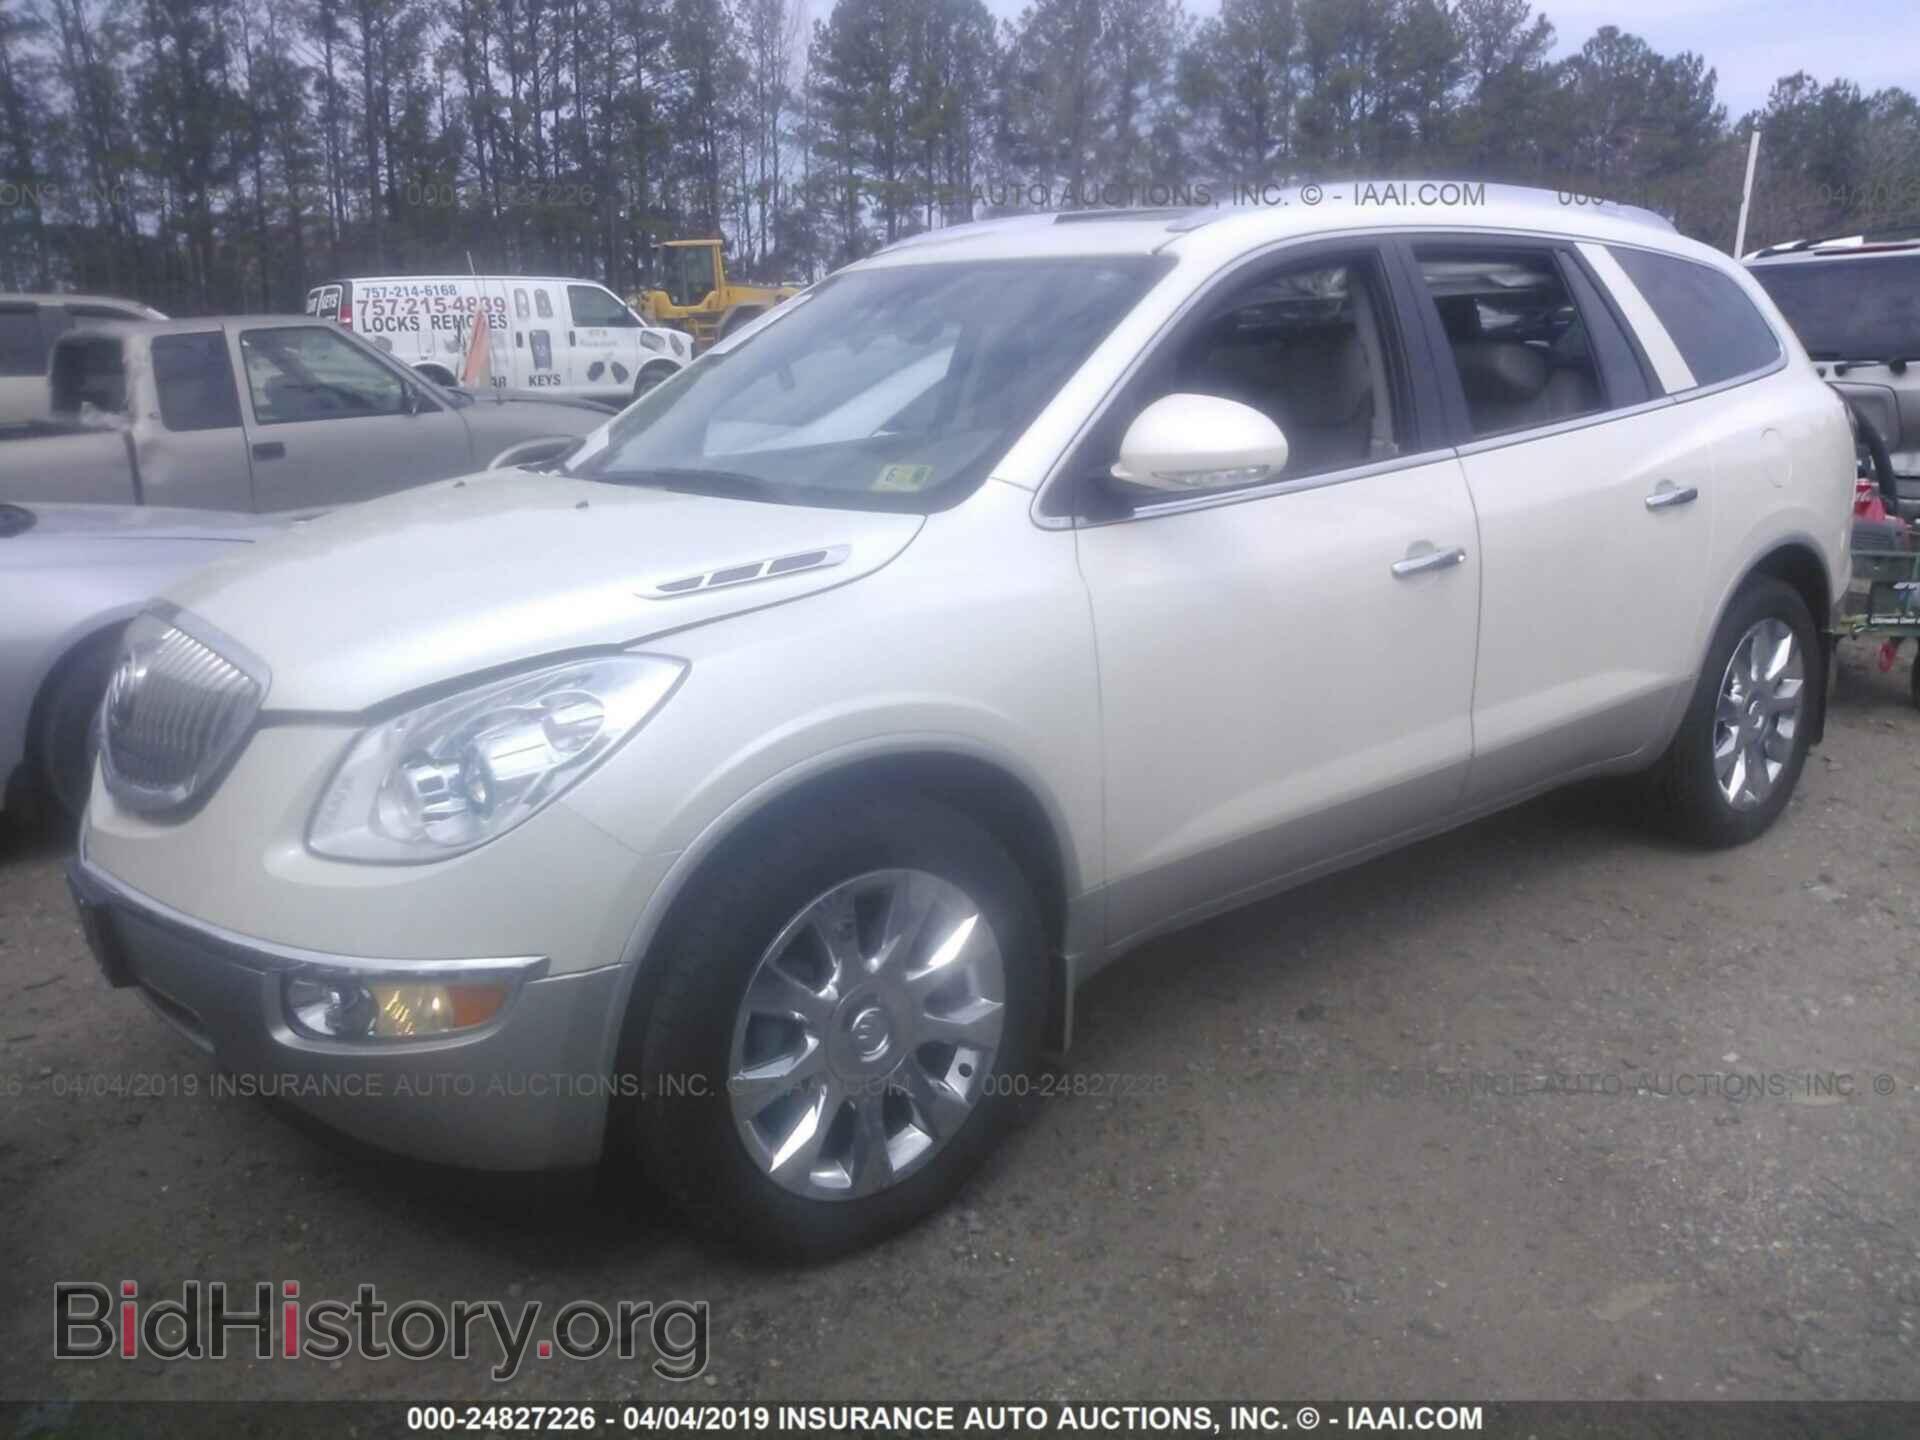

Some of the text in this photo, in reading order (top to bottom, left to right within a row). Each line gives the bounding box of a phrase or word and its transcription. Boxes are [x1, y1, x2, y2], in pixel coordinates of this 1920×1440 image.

[362, 285, 457, 299] 757-214-6168
[363, 316, 420, 332] LOCKS
[528, 374, 561, 387] KEYS
